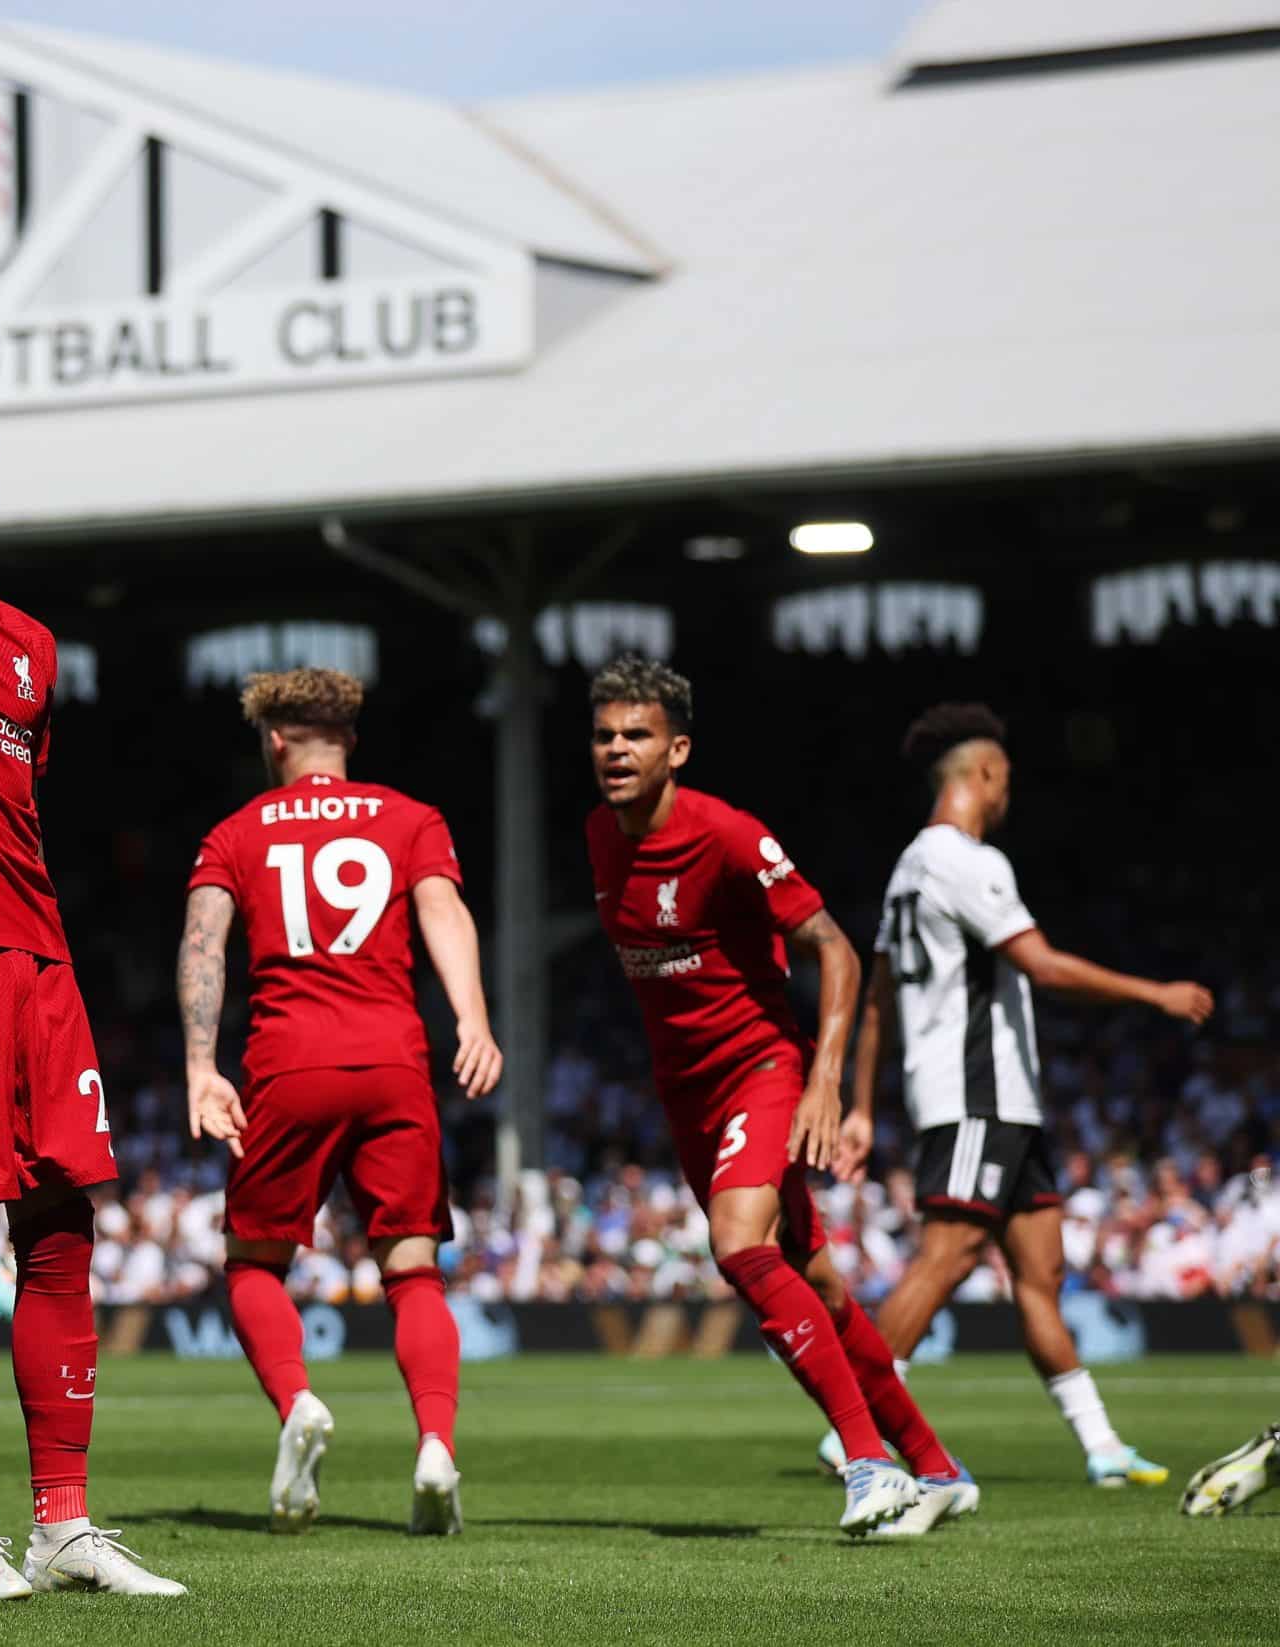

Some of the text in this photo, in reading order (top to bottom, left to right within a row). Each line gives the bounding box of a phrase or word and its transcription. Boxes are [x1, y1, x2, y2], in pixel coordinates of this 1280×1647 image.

[277, 288, 477, 367] CLUB
[261, 796, 383, 825] ELLIOTT
[265, 836, 393, 958] 19
[717, 1111, 749, 1161] 3
